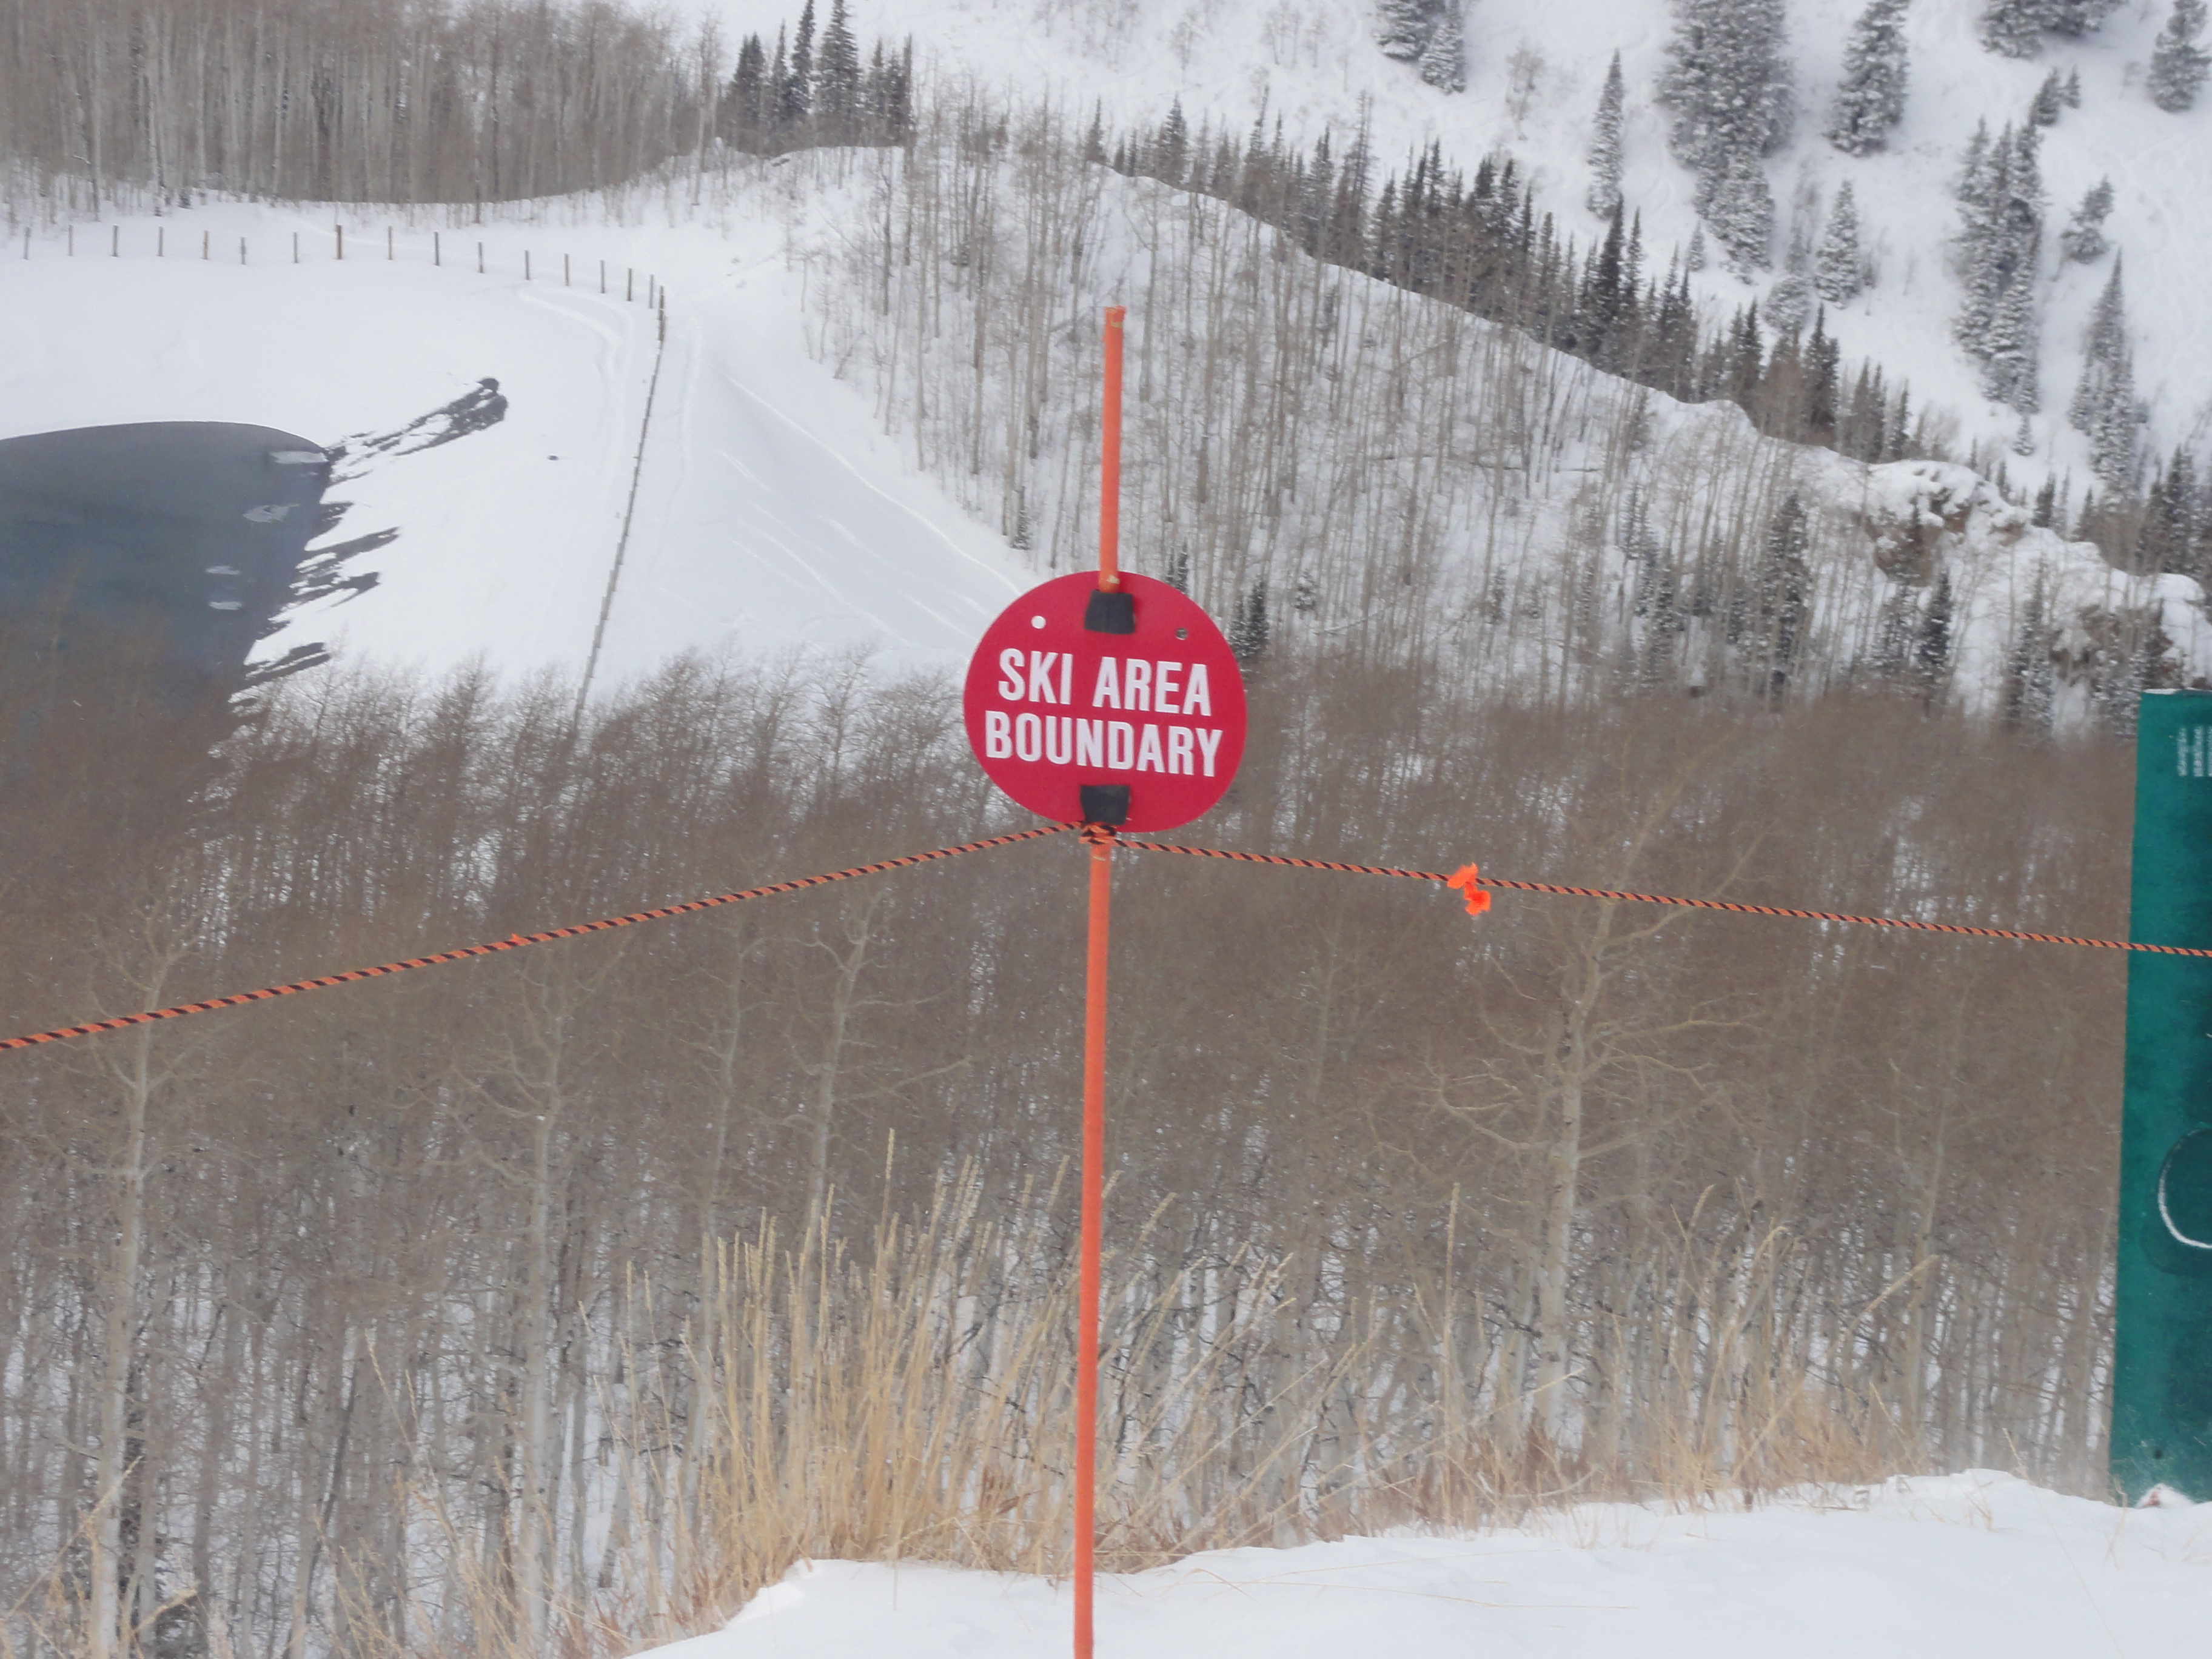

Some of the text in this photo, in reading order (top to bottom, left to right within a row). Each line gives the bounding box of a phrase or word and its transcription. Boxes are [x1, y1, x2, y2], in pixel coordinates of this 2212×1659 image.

[998, 648, 1212, 717] SKI AREA
[985, 710, 1223, 777] BOUNDARY
